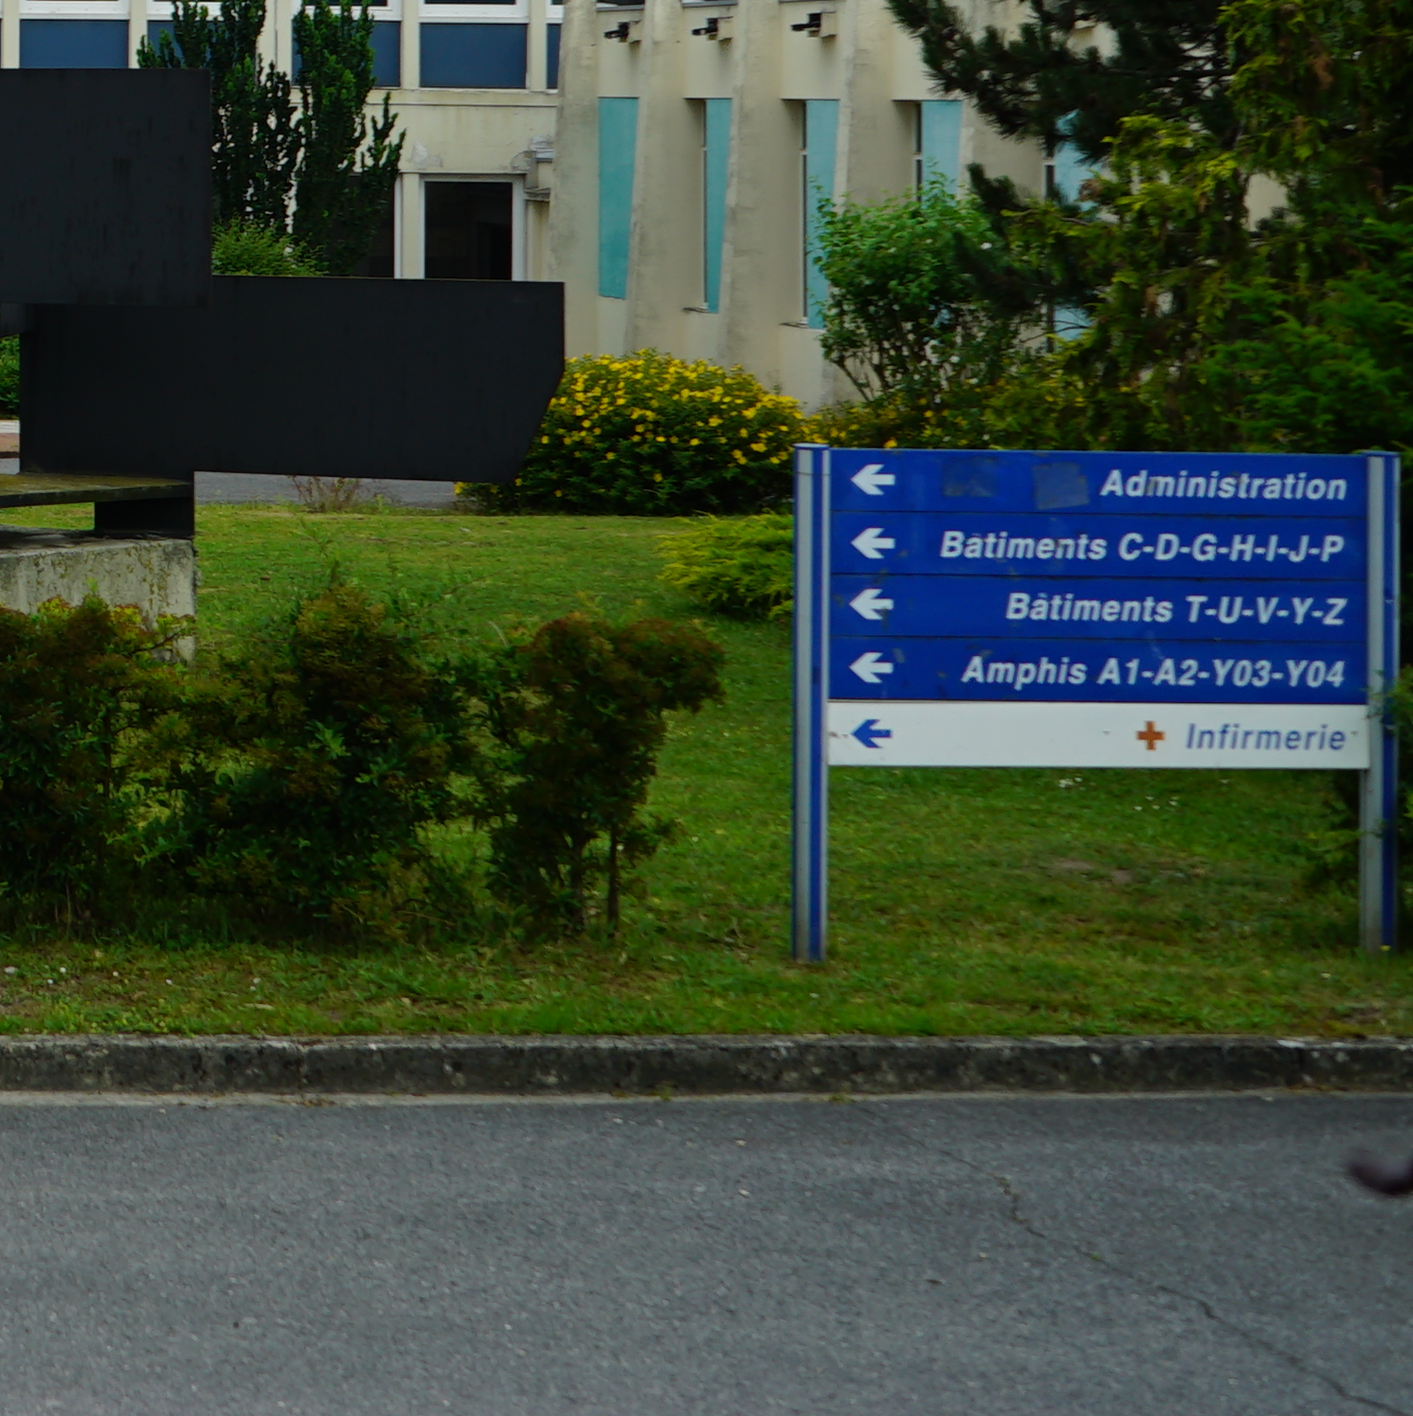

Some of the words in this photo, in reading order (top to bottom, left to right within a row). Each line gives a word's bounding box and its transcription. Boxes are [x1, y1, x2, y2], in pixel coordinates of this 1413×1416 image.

[1099, 469, 1347, 501] Administration
[939, 530, 1108, 561] Bâtiments
[1118, 533, 1345, 563] C-D-G-H-I-J-P
[1005, 592, 1173, 623] Bâtiments
[1186, 595, 1348, 626] T-U-V-Y-Z
[961, 655, 1087, 690] Amphis
[1096, 657, 1345, 688] A1-A2-Y03-Y04
[1186, 723, 1347, 751] Infirmerie
